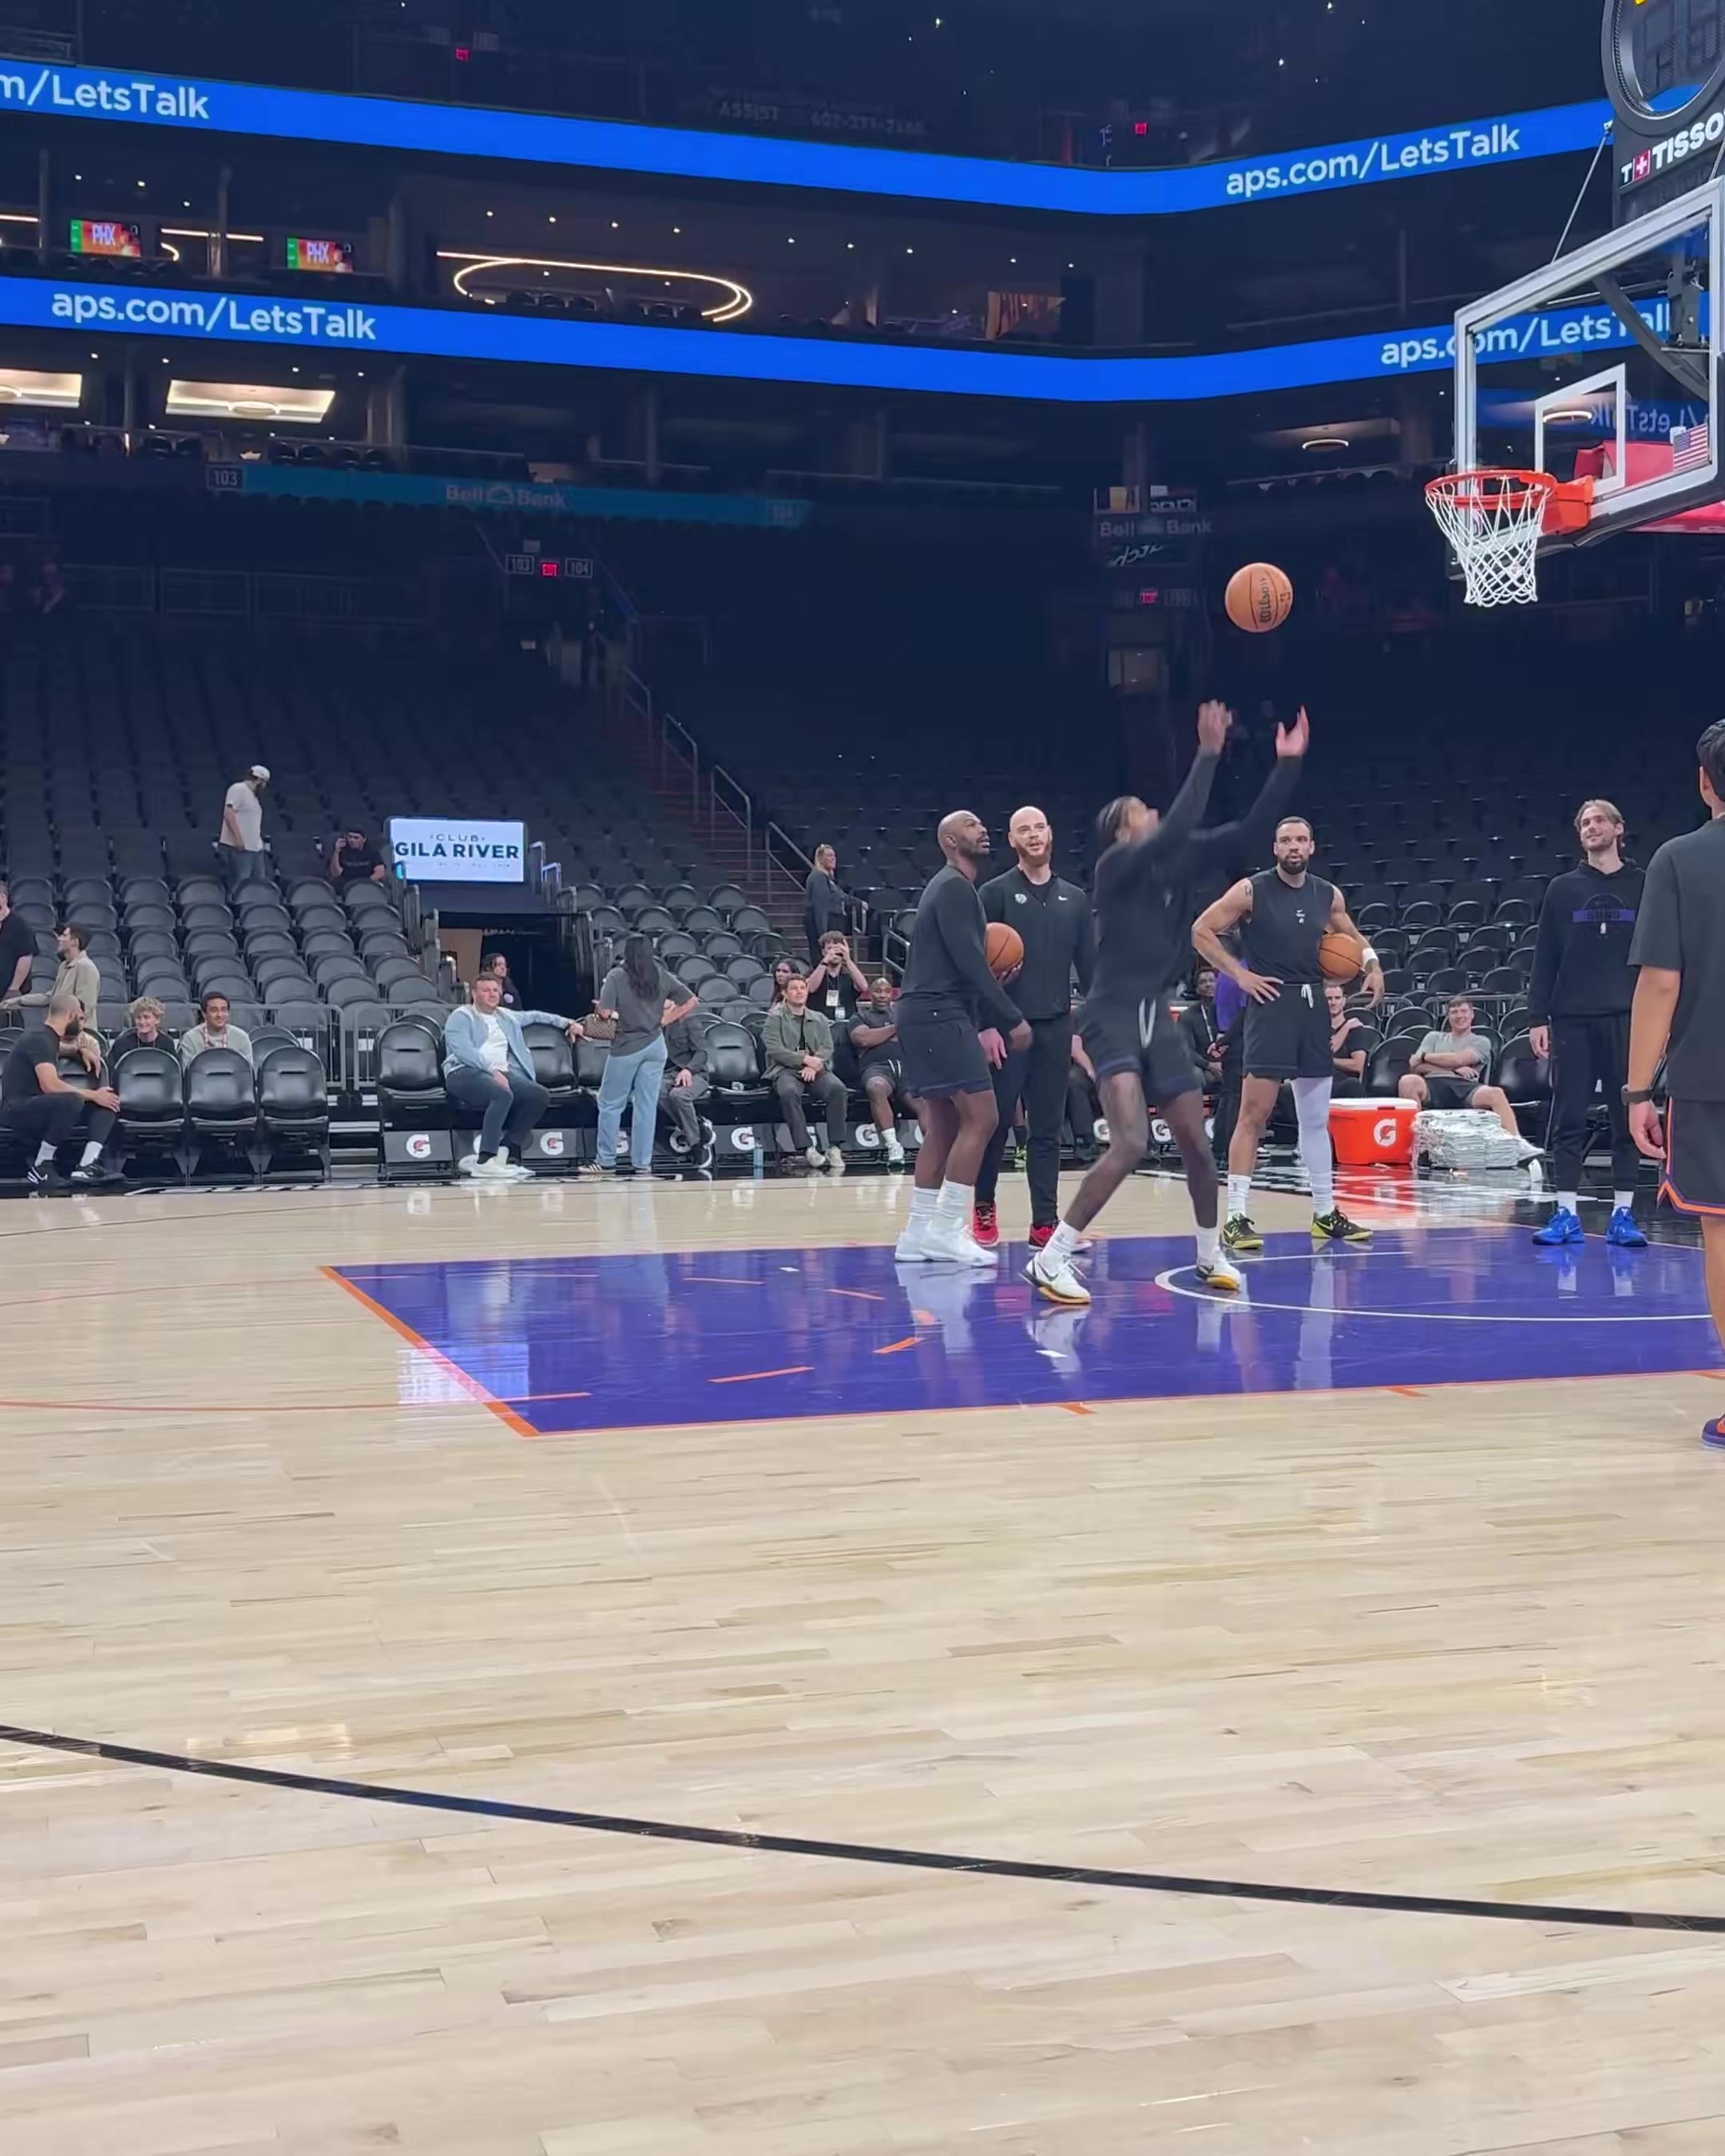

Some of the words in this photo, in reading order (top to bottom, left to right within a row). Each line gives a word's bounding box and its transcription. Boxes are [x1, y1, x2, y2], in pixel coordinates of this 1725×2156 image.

[1652, 108, 1725, 170] TISSO
[1226, 123, 1521, 198] aps.com/LetsTalk
[92, 223, 116, 246] PHX
[51, 291, 376, 340] aps.com/LetsTalk
[214, 470, 238, 486] 103
[446, 485, 483, 502] Bell
[517, 488, 568, 509] Bank
[1166, 518, 1213, 535] Bank
[435, 833, 479, 842] CLUB
[395, 842, 447, 858] GILA
[453, 843, 519, 859] RIVER
[540, 1131, 565, 1155] G
[732, 1126, 755, 1151] G
[855, 1124, 879, 1147] G
[1374, 1118, 1397, 1147] G
[406, 1134, 432, 1159] G
